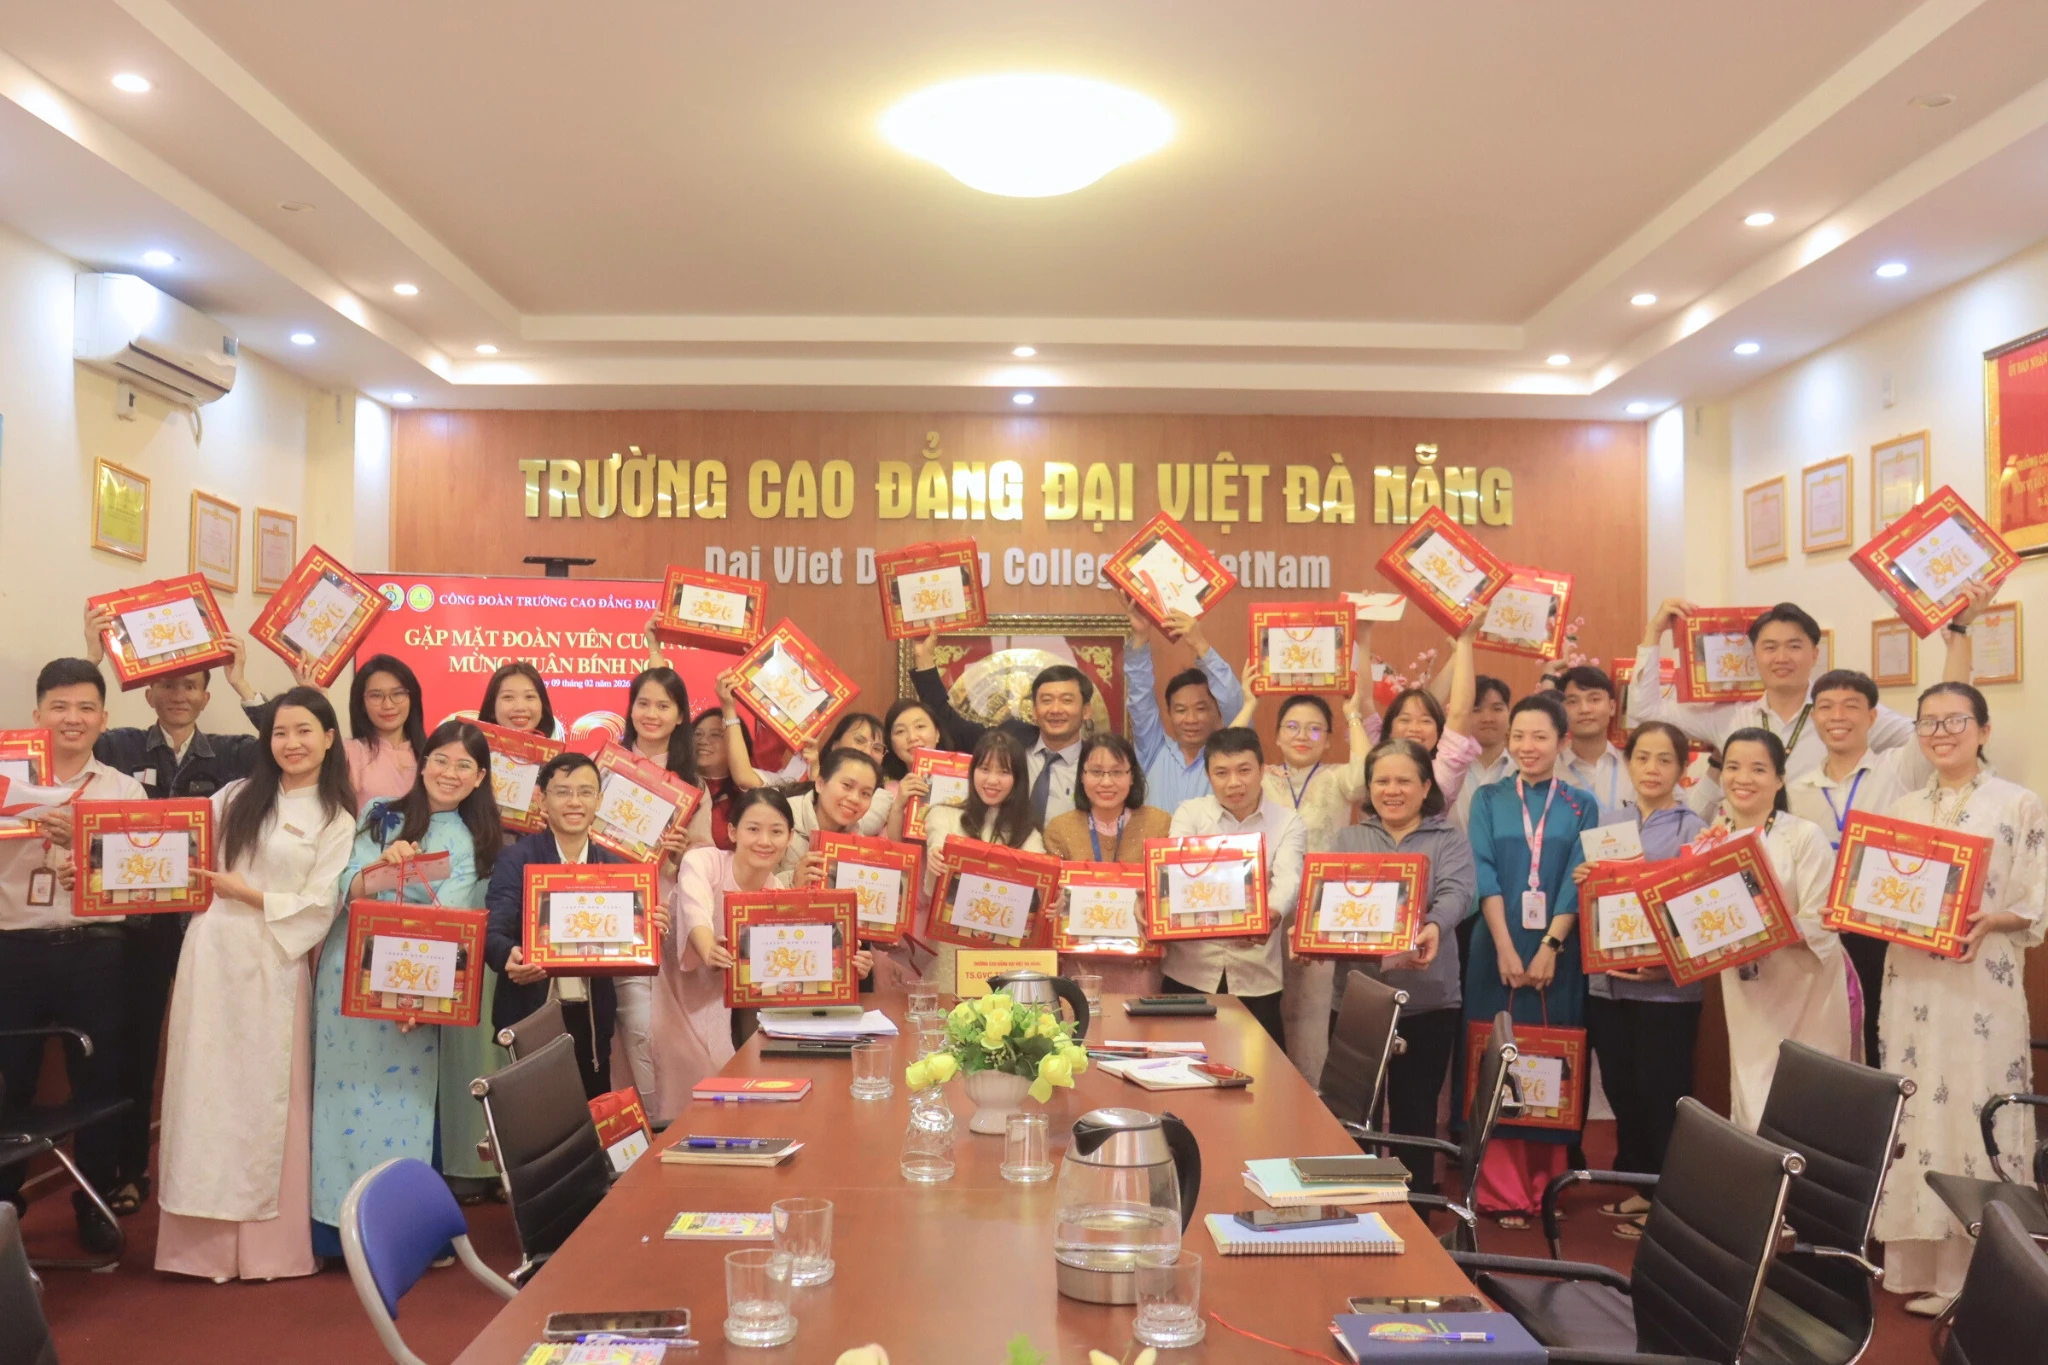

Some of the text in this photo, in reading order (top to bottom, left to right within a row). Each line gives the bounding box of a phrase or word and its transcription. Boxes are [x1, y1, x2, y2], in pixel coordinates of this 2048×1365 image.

[519, 431, 1514, 535] TRƯỜNG CAO ĐẲNG ĐẠI VIỆT ĐÀ NẴNG
[704, 545, 761, 582] Dai
[774, 545, 843, 585] Viet
[1003, 547, 1116, 590] Colleg
[1208, 549, 1331, 588] etNam
[439, 592, 657, 612] CÔNG ĐOÀN TRƯỜNG CAO ĐẲNG ĐẠI
[404, 625, 449, 650] GẶP
[451, 626, 500, 651] MẶT
[502, 626, 565, 648] ĐOÀN
[567, 627, 614, 648] VIÊN
[576, 654, 627, 675] BÍNH
[551, 679, 561, 688] 09
[562, 679, 584, 690] tháng
[585, 680, 594, 688] 02
[595, 679, 612, 689] năm
[613, 680, 631, 689] 2026
